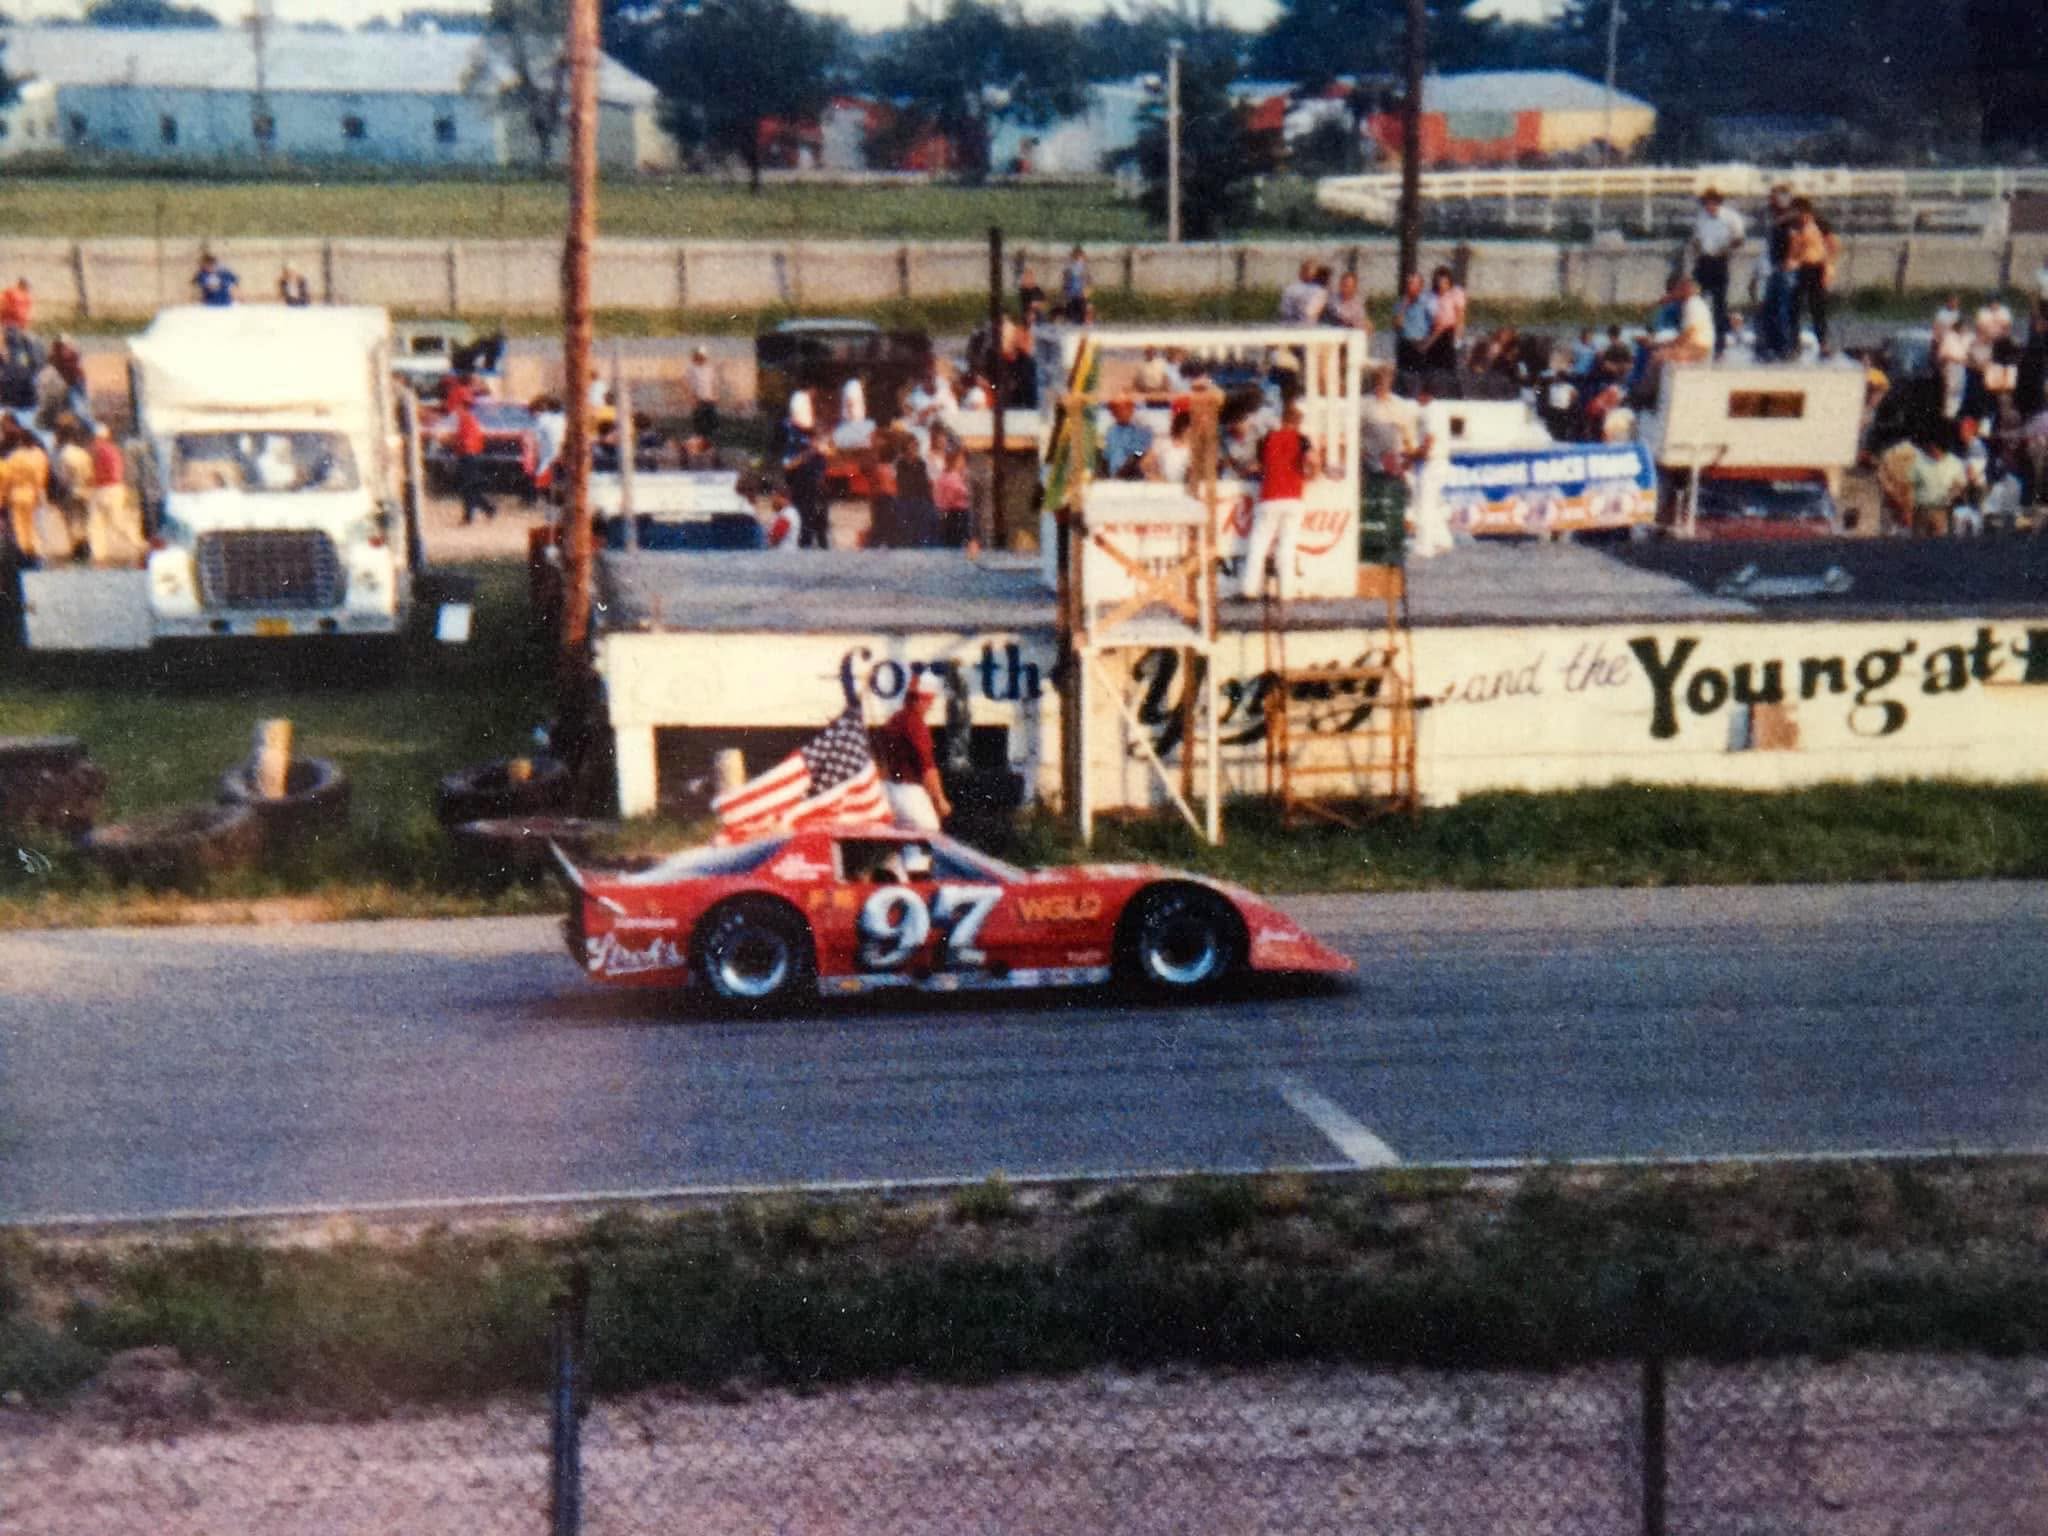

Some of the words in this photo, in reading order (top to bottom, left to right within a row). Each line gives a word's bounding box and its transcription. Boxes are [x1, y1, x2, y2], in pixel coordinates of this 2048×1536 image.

[1463, 650, 1546, 703] and
[1561, 642, 1633, 692] the
[1627, 636, 1918, 738] Young
[859, 885, 1005, 968] 97
